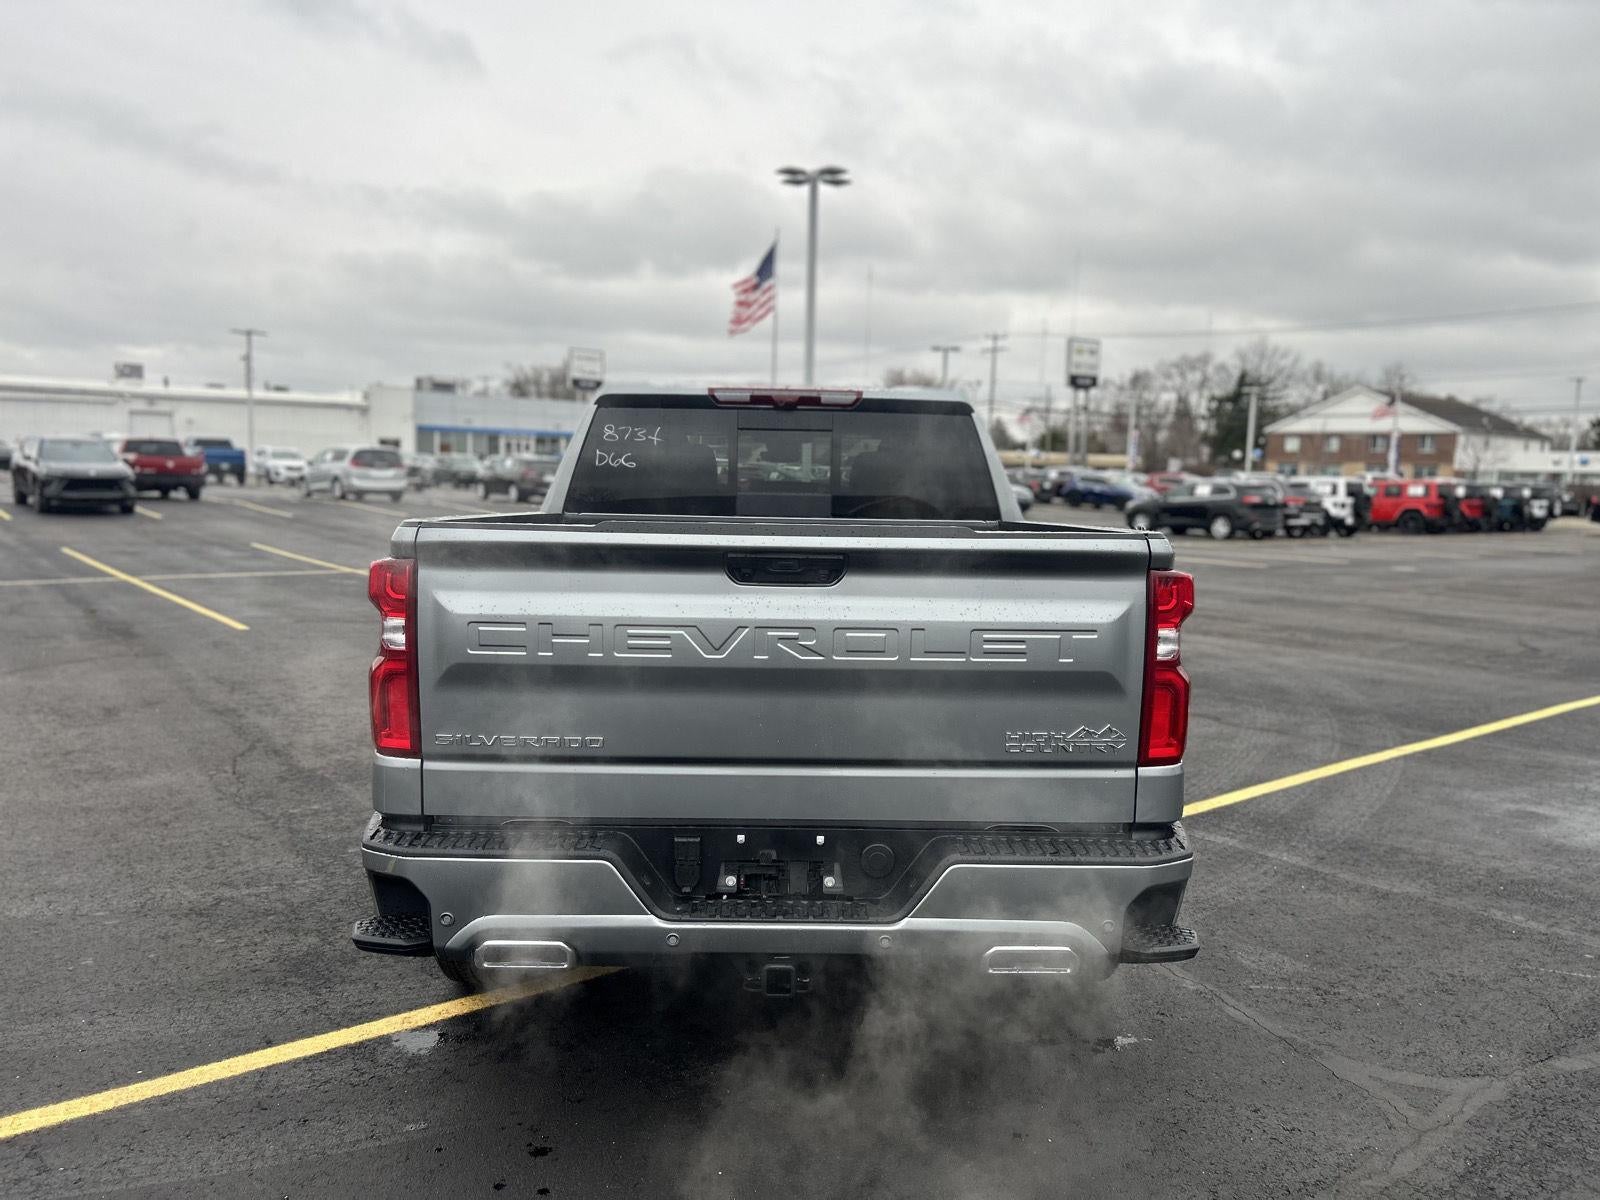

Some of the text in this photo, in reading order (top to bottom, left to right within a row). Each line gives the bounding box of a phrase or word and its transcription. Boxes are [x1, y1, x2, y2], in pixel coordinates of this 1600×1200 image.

[466, 621, 1098, 662] CHEVROLET
[434, 734, 605, 748] SILVERADO
[1005, 731, 1066, 742] HIGH
[1005, 743, 1127, 754] COUNTRY
